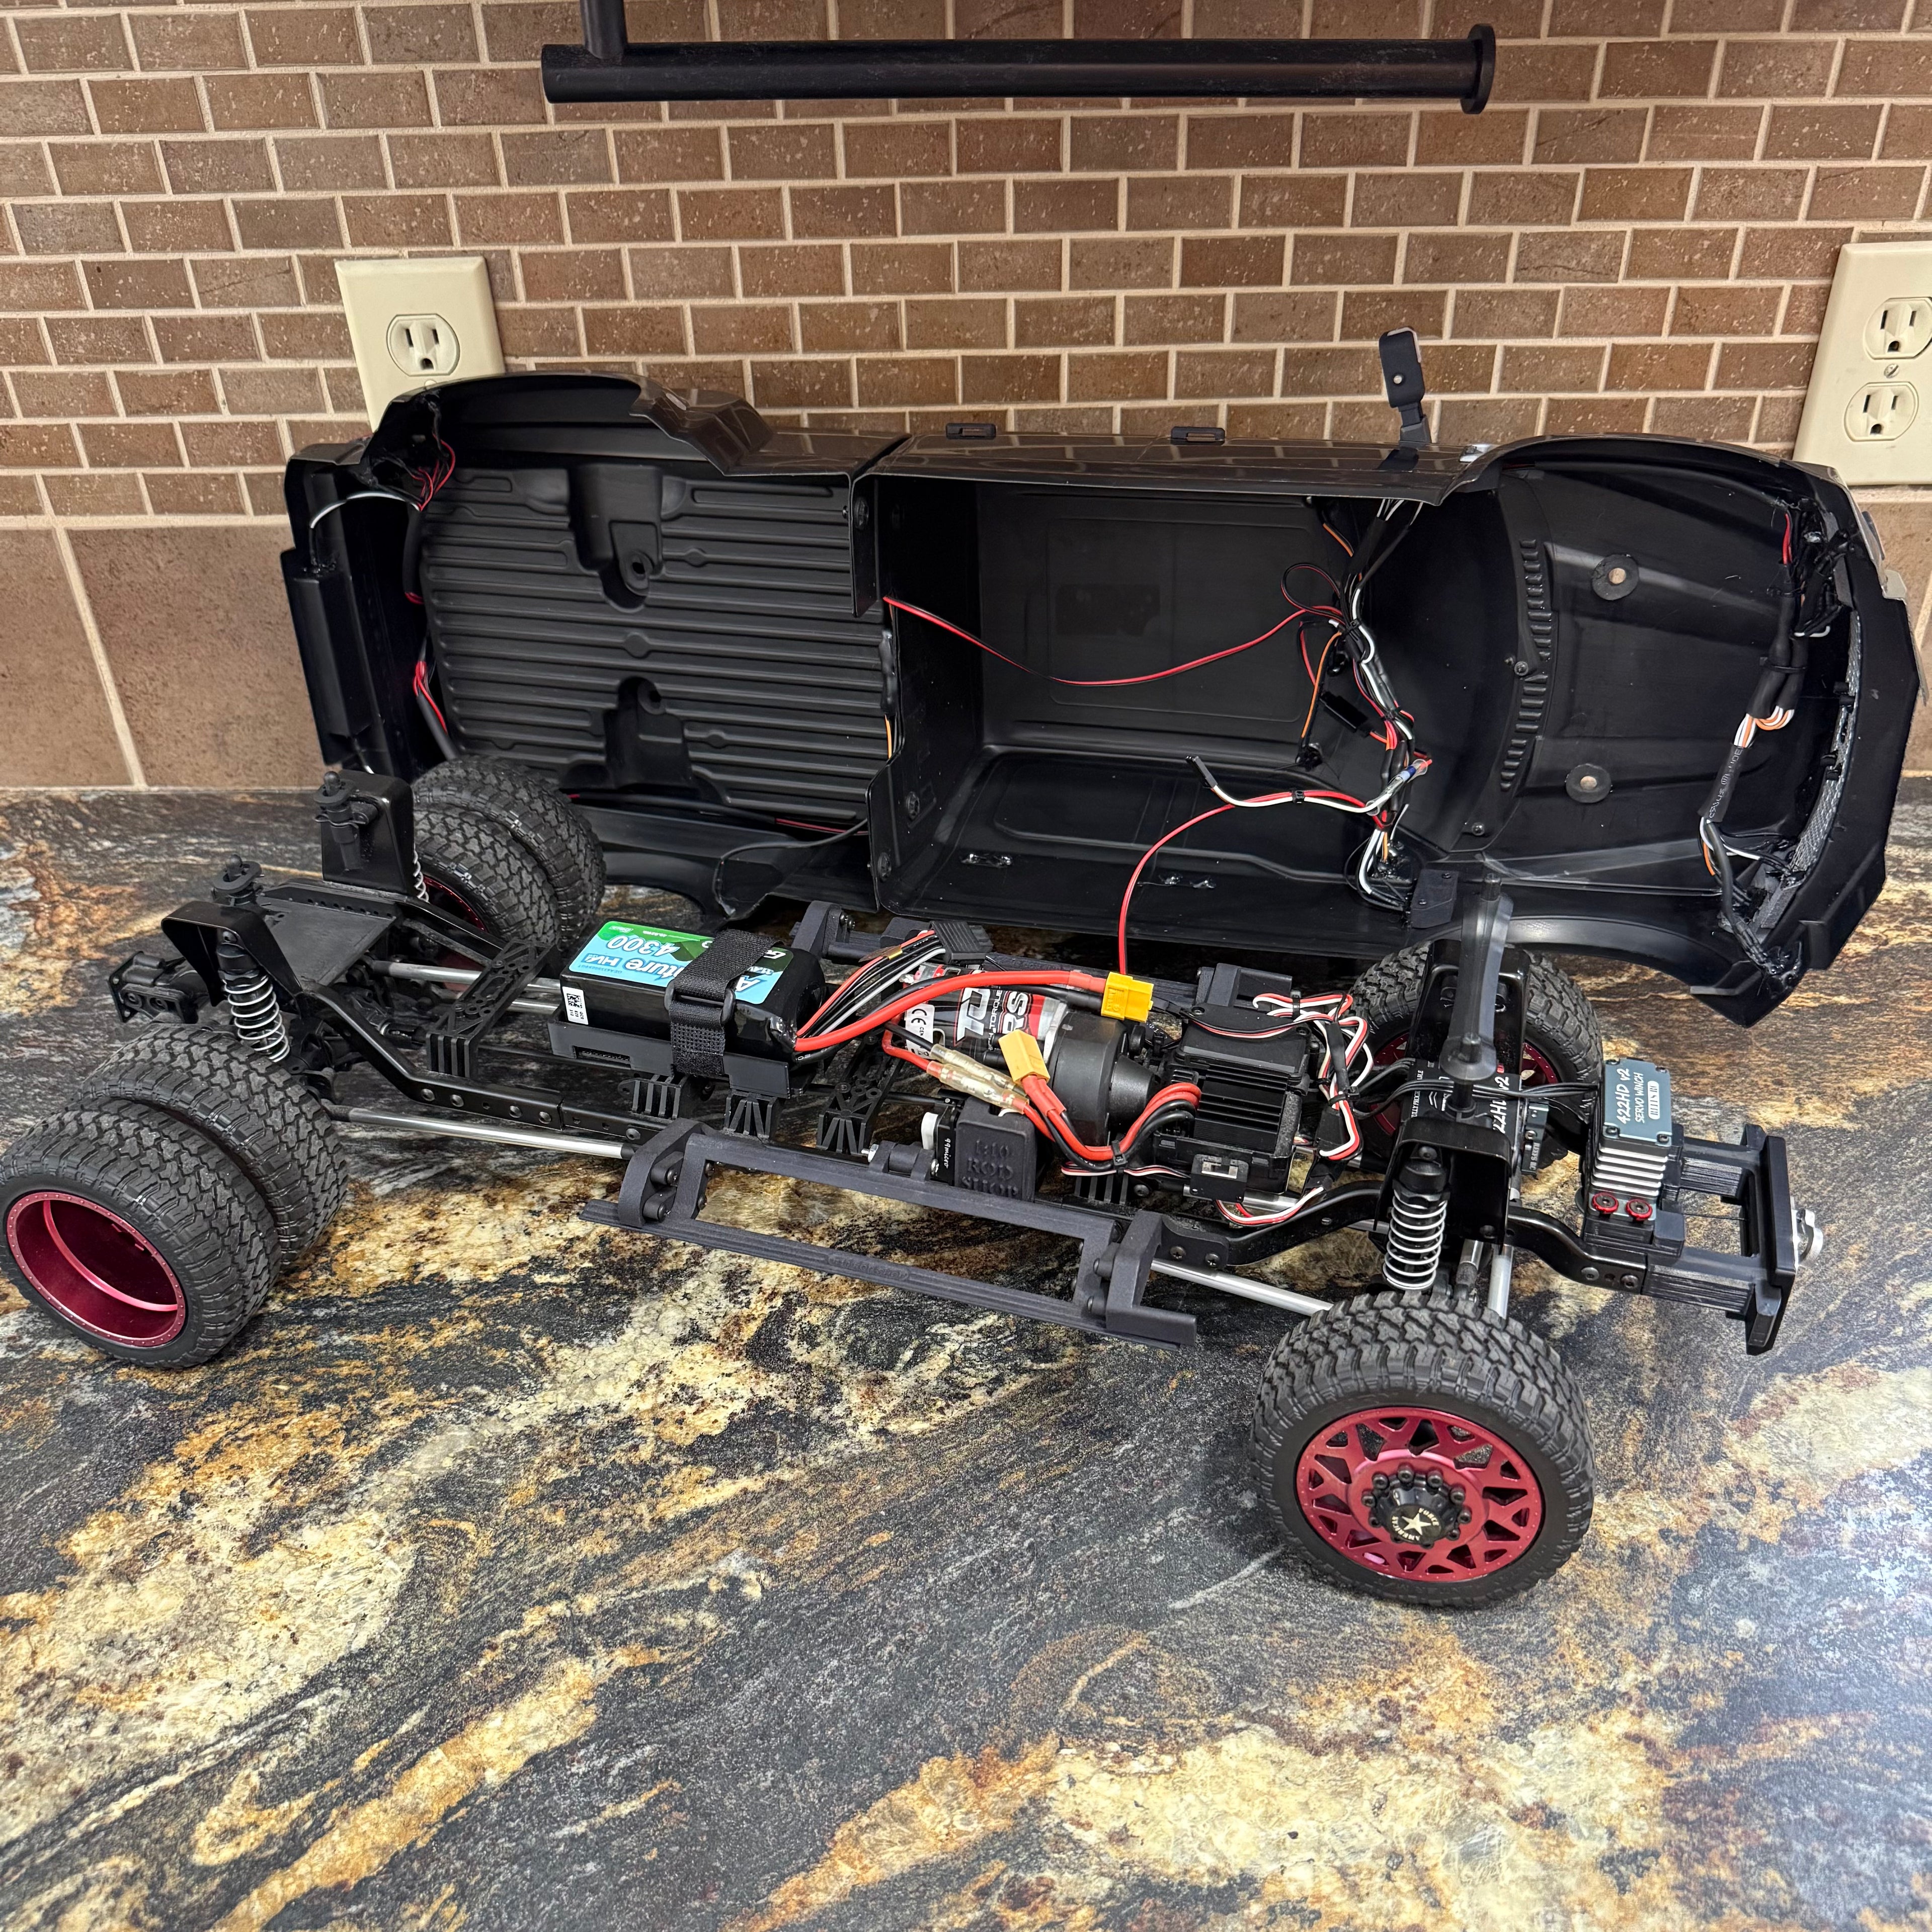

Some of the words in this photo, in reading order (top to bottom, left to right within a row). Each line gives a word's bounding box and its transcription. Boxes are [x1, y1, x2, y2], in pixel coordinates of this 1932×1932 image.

[607, 935, 680, 956] 4300
[911, 1009, 927, 1025] CE
[989, 990, 1002, 1029] TORQUE
[1495, 1076, 1509, 1090] v2
[1617, 1068, 1630, 1081] v2
[1633, 1072, 1644, 1096] WINCH
[1615, 1084, 1631, 1124] 422HD
[1634, 1097, 1645, 1123] SERVO
[943, 1138, 951, 1169] 99micro
[968, 1157, 1013, 1180] ROD
